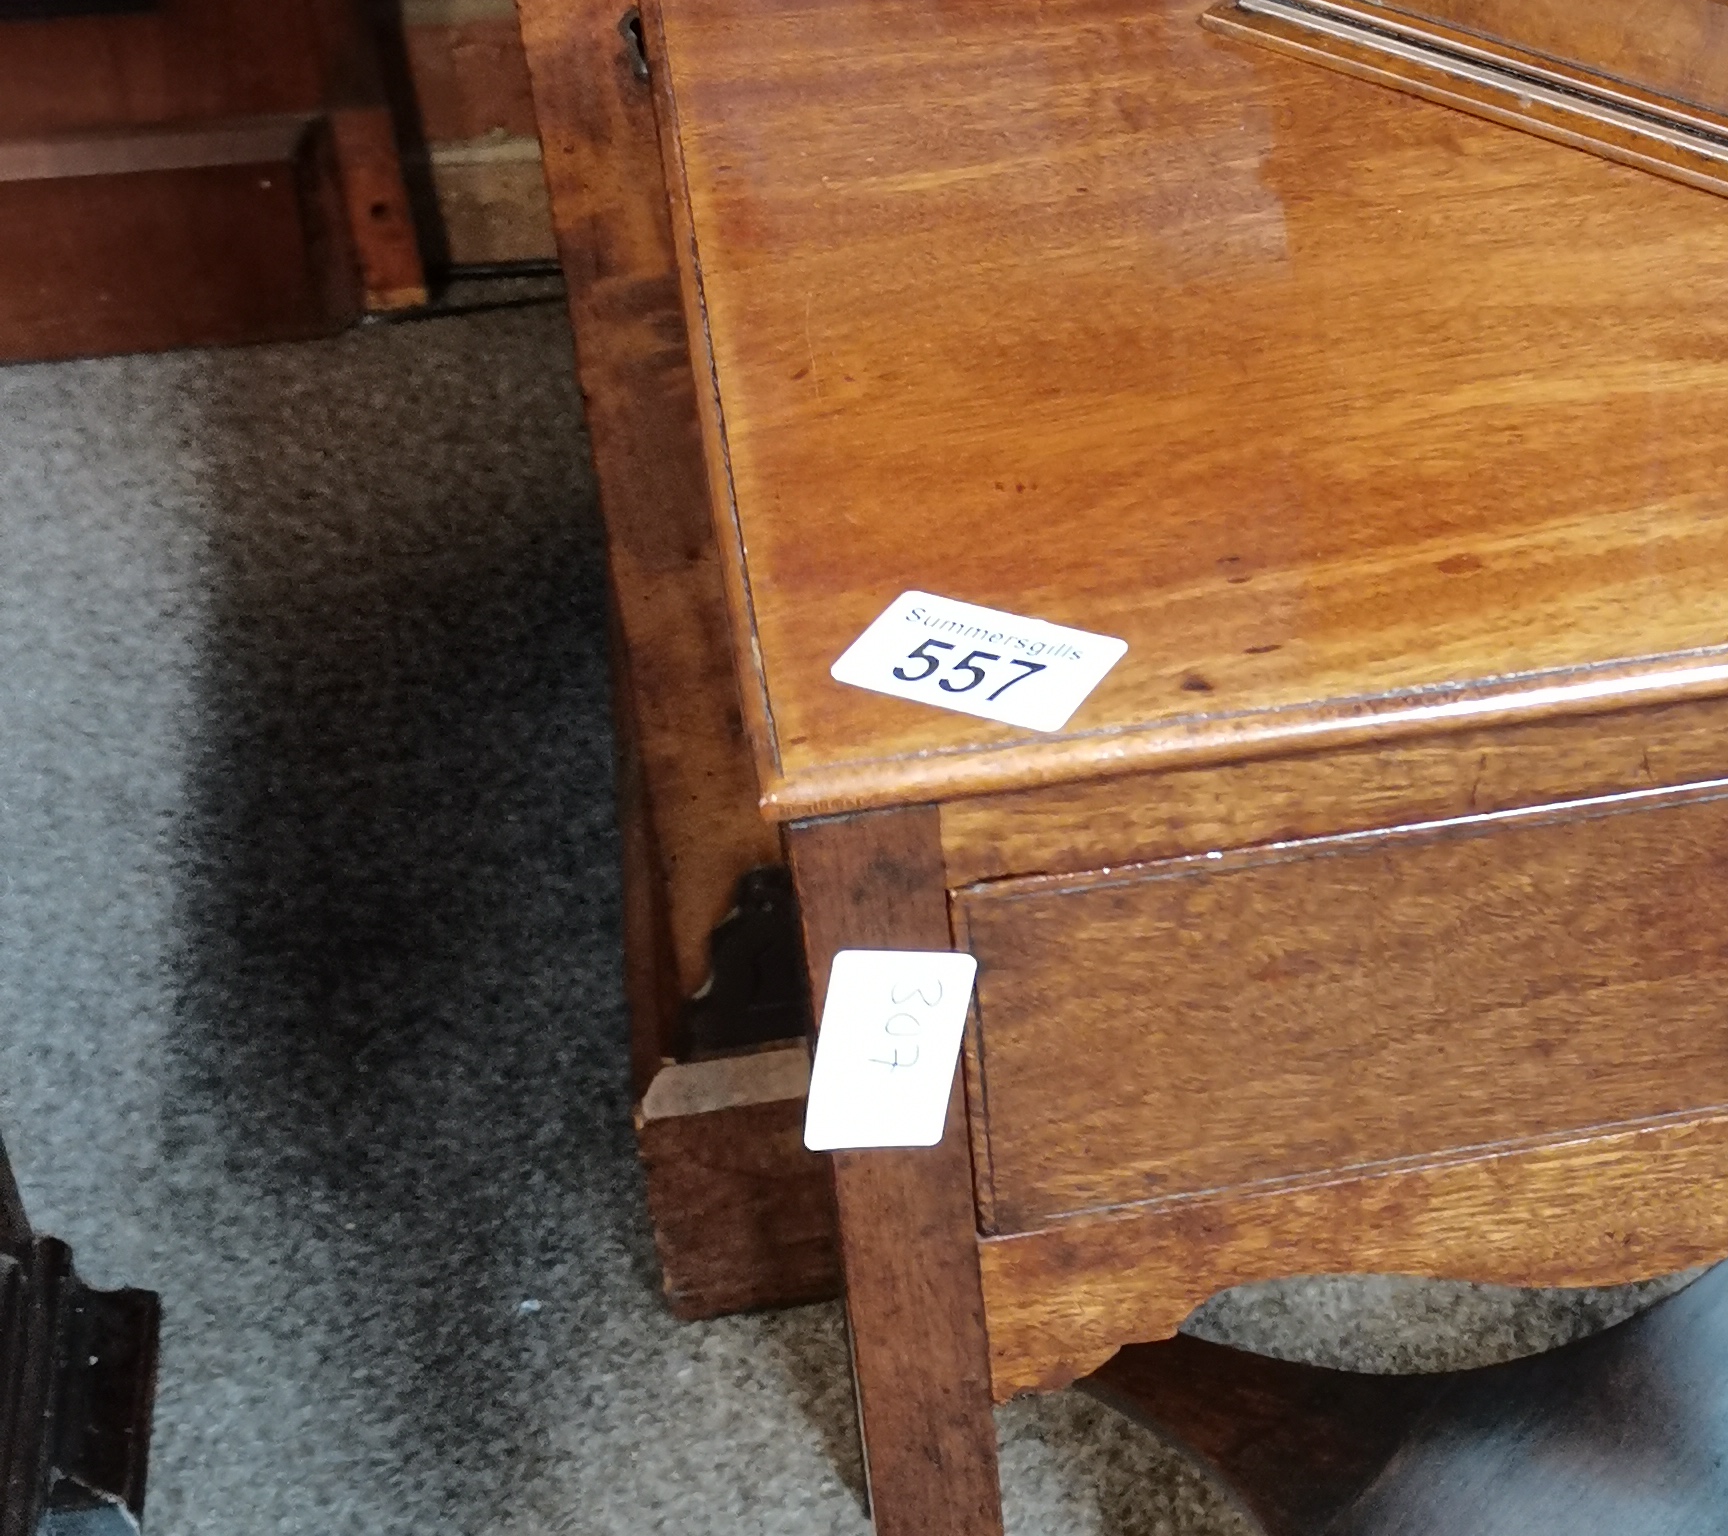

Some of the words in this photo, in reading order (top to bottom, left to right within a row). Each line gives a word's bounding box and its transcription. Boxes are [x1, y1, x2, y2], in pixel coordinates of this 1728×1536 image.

[905, 606, 1084, 662] Summersgills
[892, 638, 1048, 702] 557
[868, 979, 943, 1073] 307
